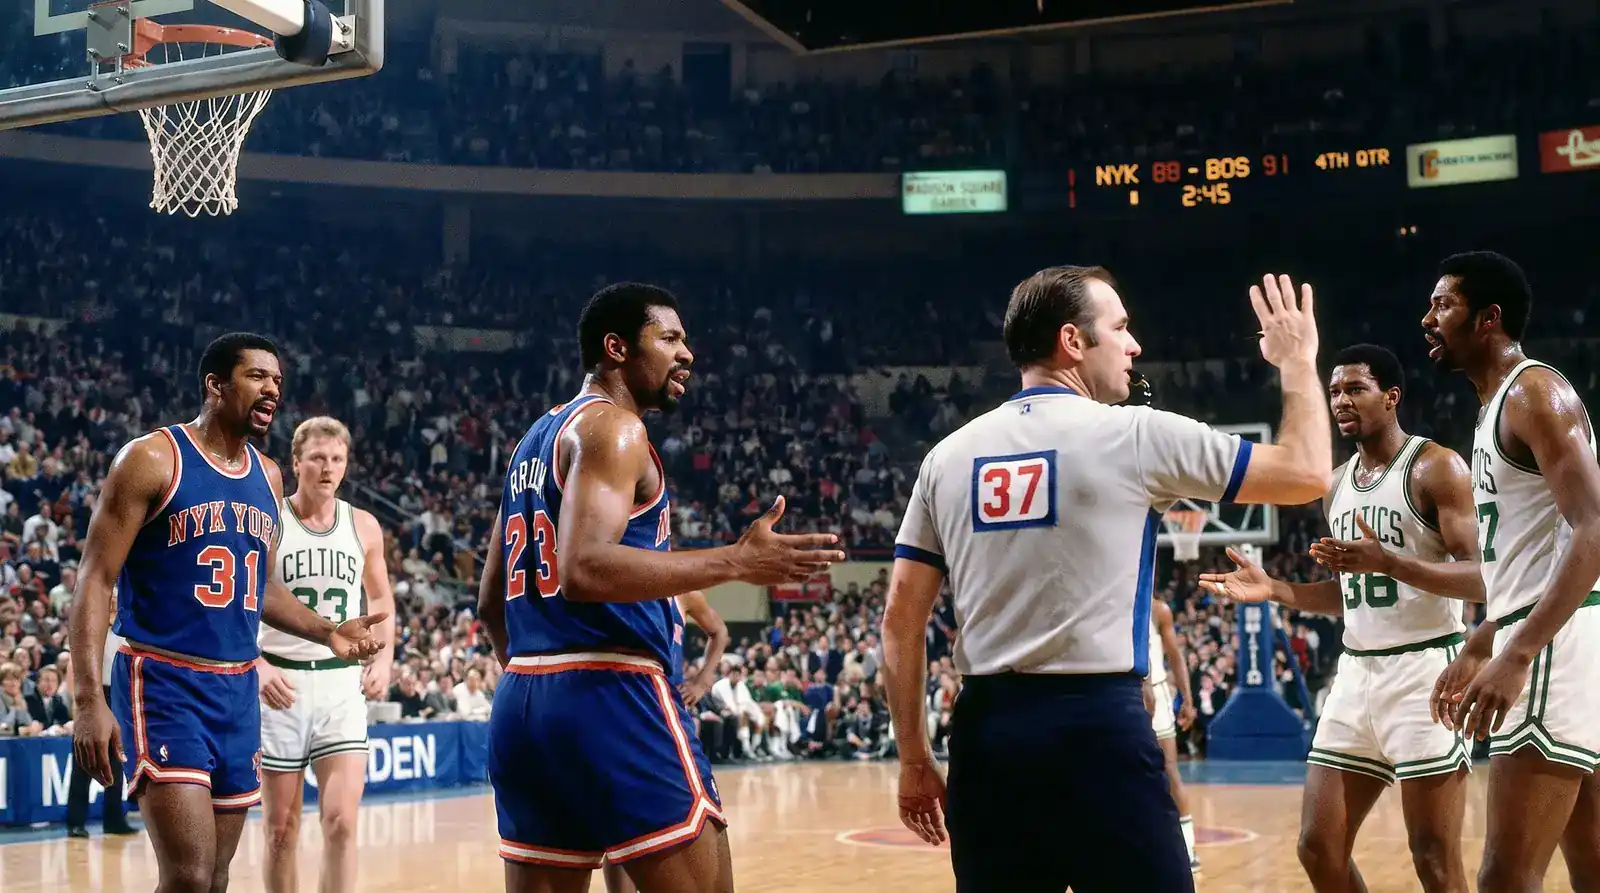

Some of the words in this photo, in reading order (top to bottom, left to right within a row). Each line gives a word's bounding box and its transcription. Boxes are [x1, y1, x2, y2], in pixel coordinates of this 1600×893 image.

[1096, 164, 1139, 186] NYK
[1152, 161, 1181, 183] 88
[1205, 156, 1250, 180] BOS
[1314, 152, 1349, 170] 4TH
[1182, 183, 1231, 207] 2:45
[983, 464, 1043, 518] 37
[168, 501, 226, 547] NYK
[231, 502, 277, 549] YOR
[1332, 505, 1405, 548] CELTICS
[1475, 501, 1499, 563] 7
[282, 548, 356, 586] CELTICS
[505, 509, 561, 601] 23
[194, 545, 259, 612] 31
